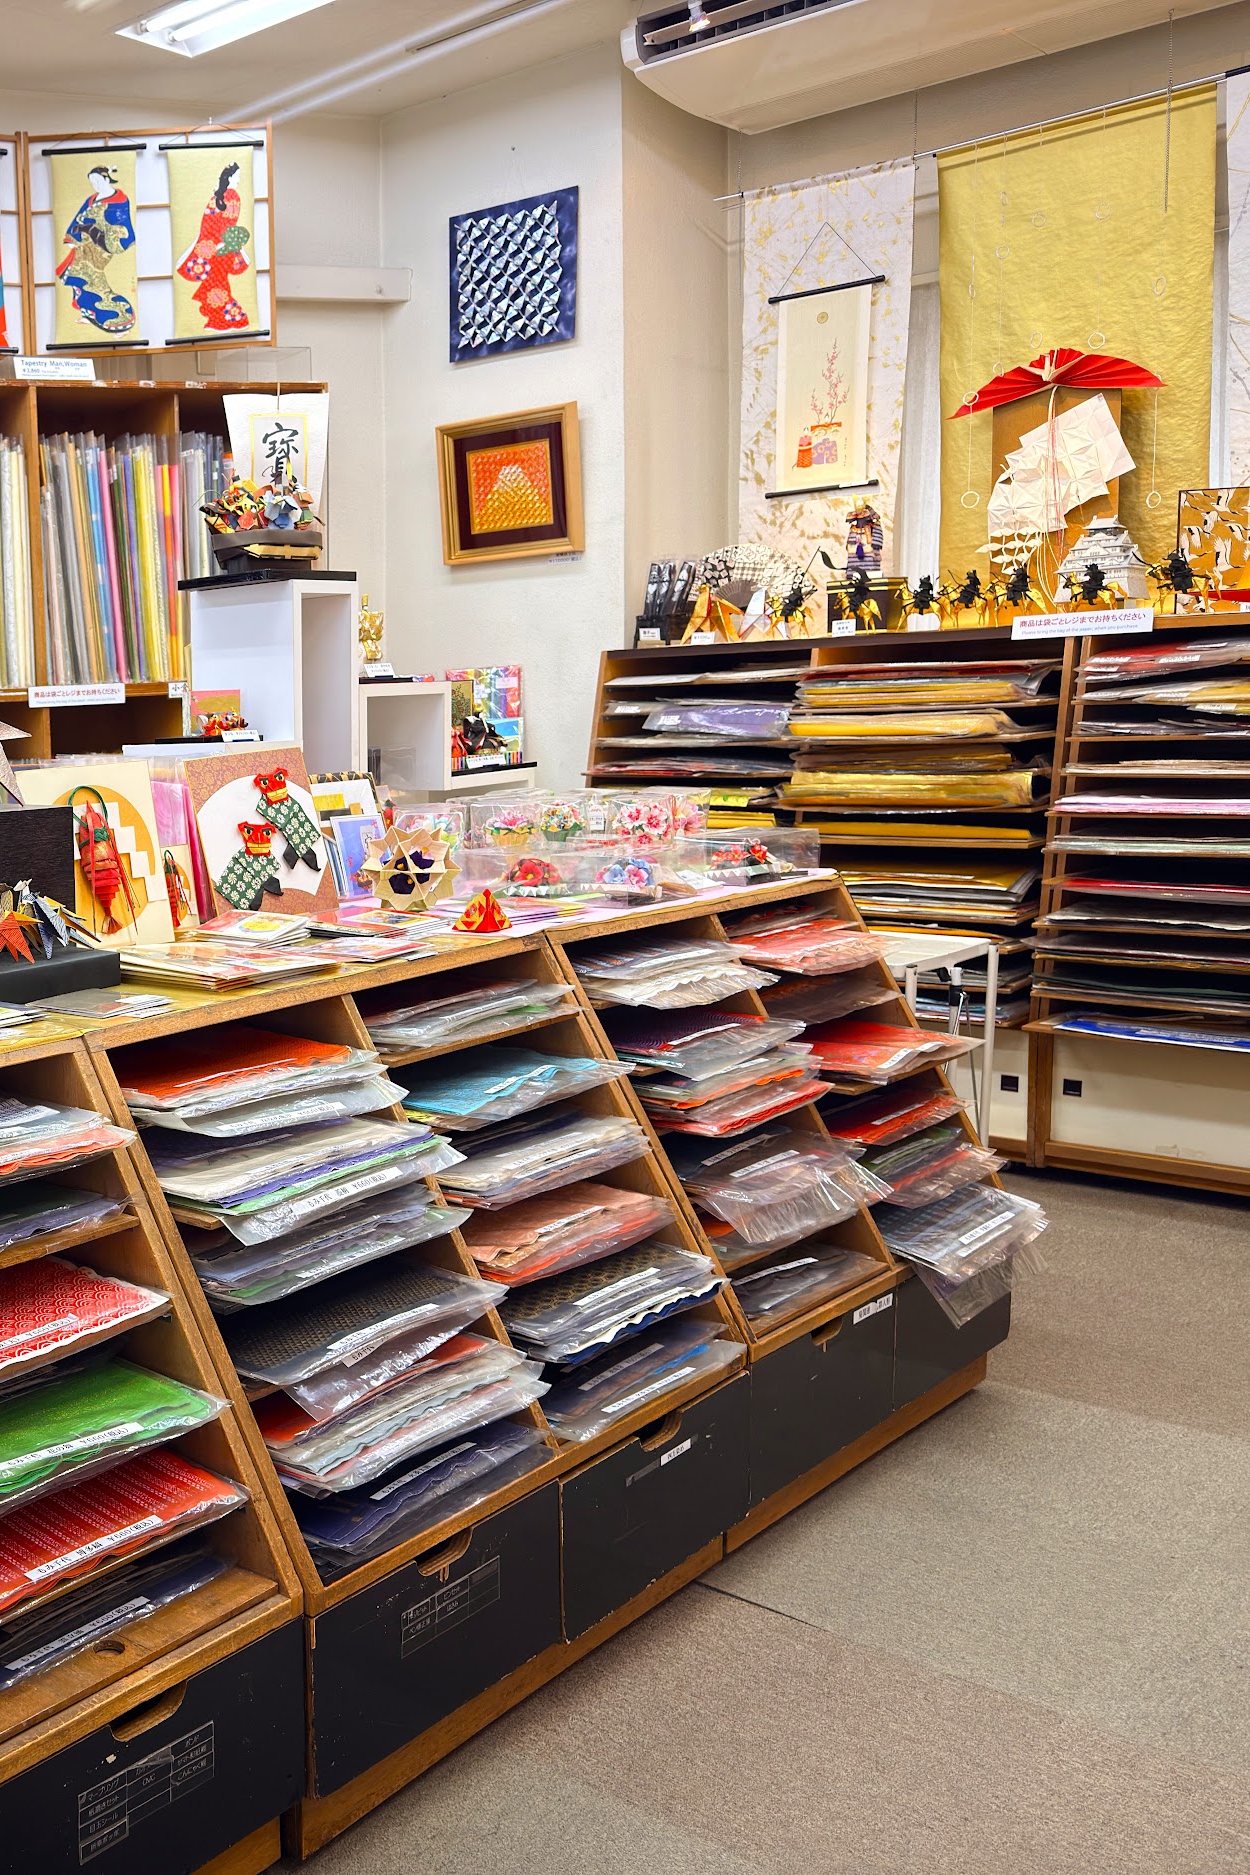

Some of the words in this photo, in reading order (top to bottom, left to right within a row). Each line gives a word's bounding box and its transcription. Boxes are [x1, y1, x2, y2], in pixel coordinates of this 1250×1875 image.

[21, 359, 48, 368] Tapestry
[1019, 612, 1146, 628] 商品は袋ごとレジまでお持ちください
